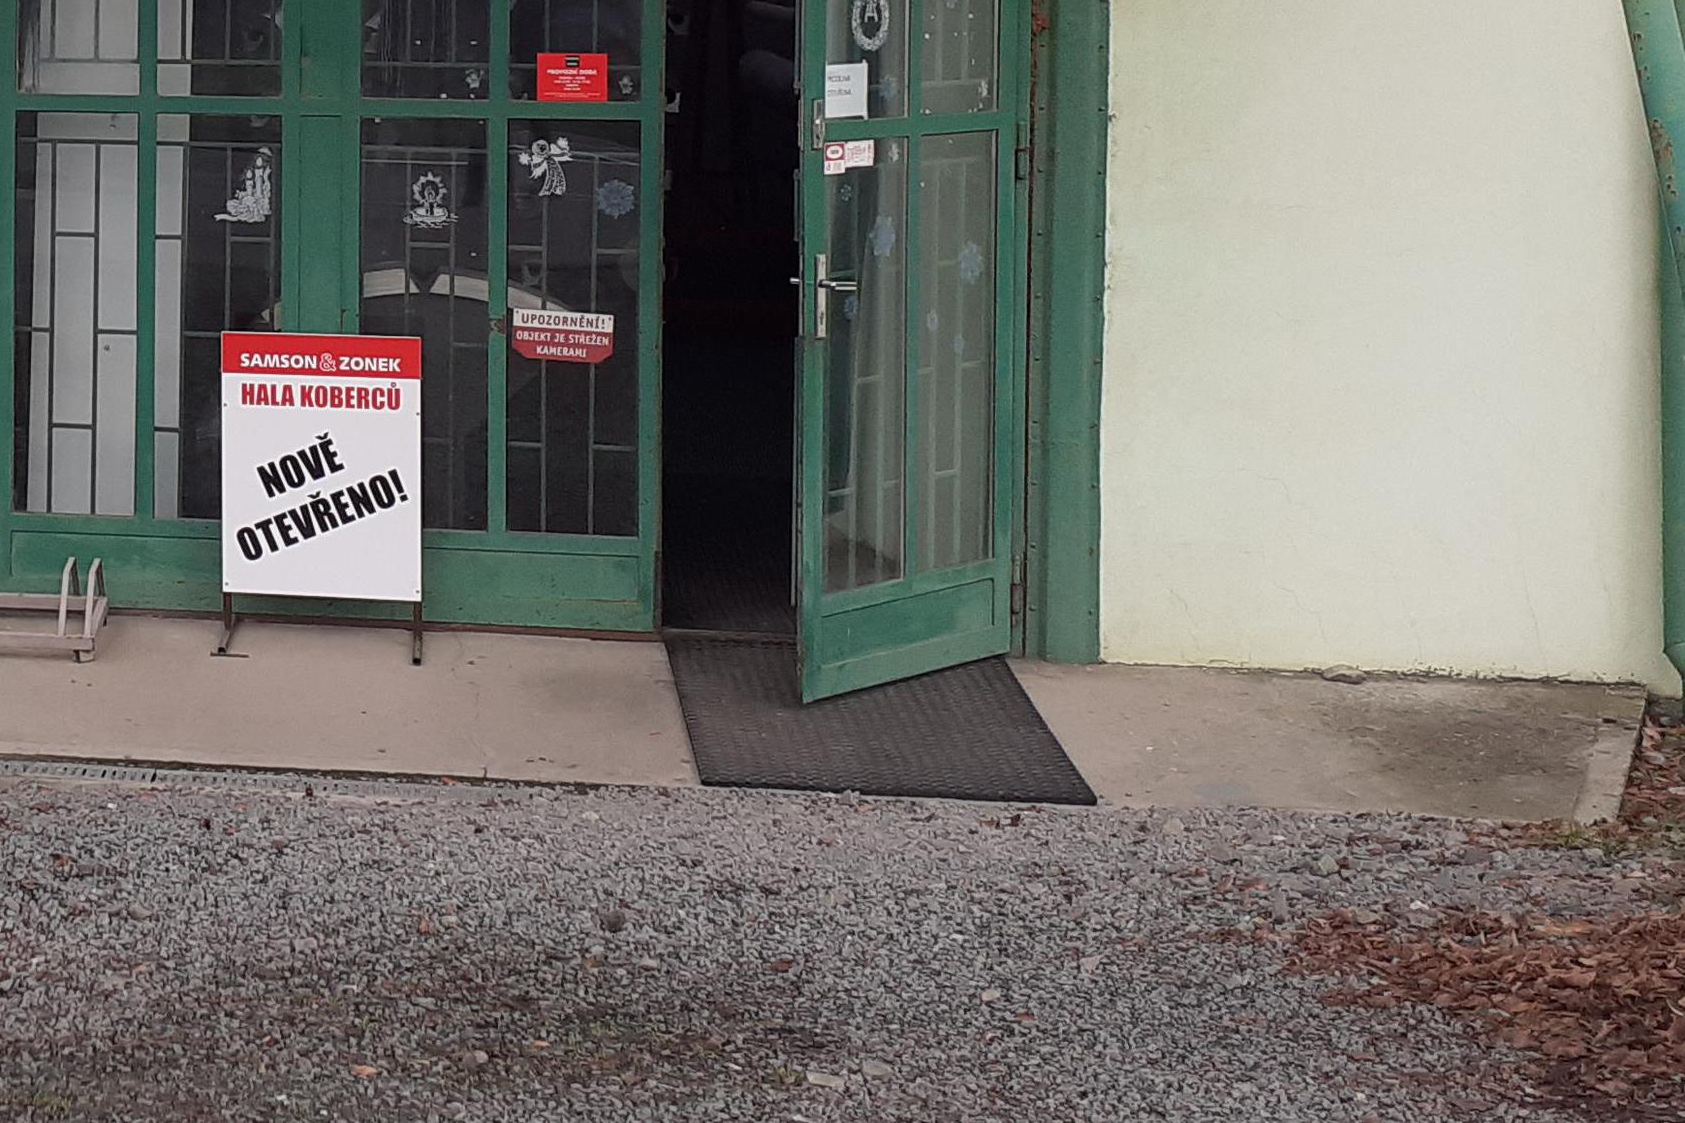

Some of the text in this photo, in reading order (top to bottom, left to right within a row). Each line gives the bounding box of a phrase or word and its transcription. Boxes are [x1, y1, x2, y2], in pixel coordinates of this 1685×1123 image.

[522, 313, 605, 329] UPOZORNĚNÍ!
[516, 331, 610, 346] OBJEKT JE STŘEŽEN
[537, 346, 586, 357] KAMERAMI
[240, 352, 401, 373] SAMSON & ZONEK
[241, 381, 402, 411] HALA KOBERCŮ
[256, 431, 345, 499] NOVĚ
[235, 468, 409, 562] OTEVŘENO!
